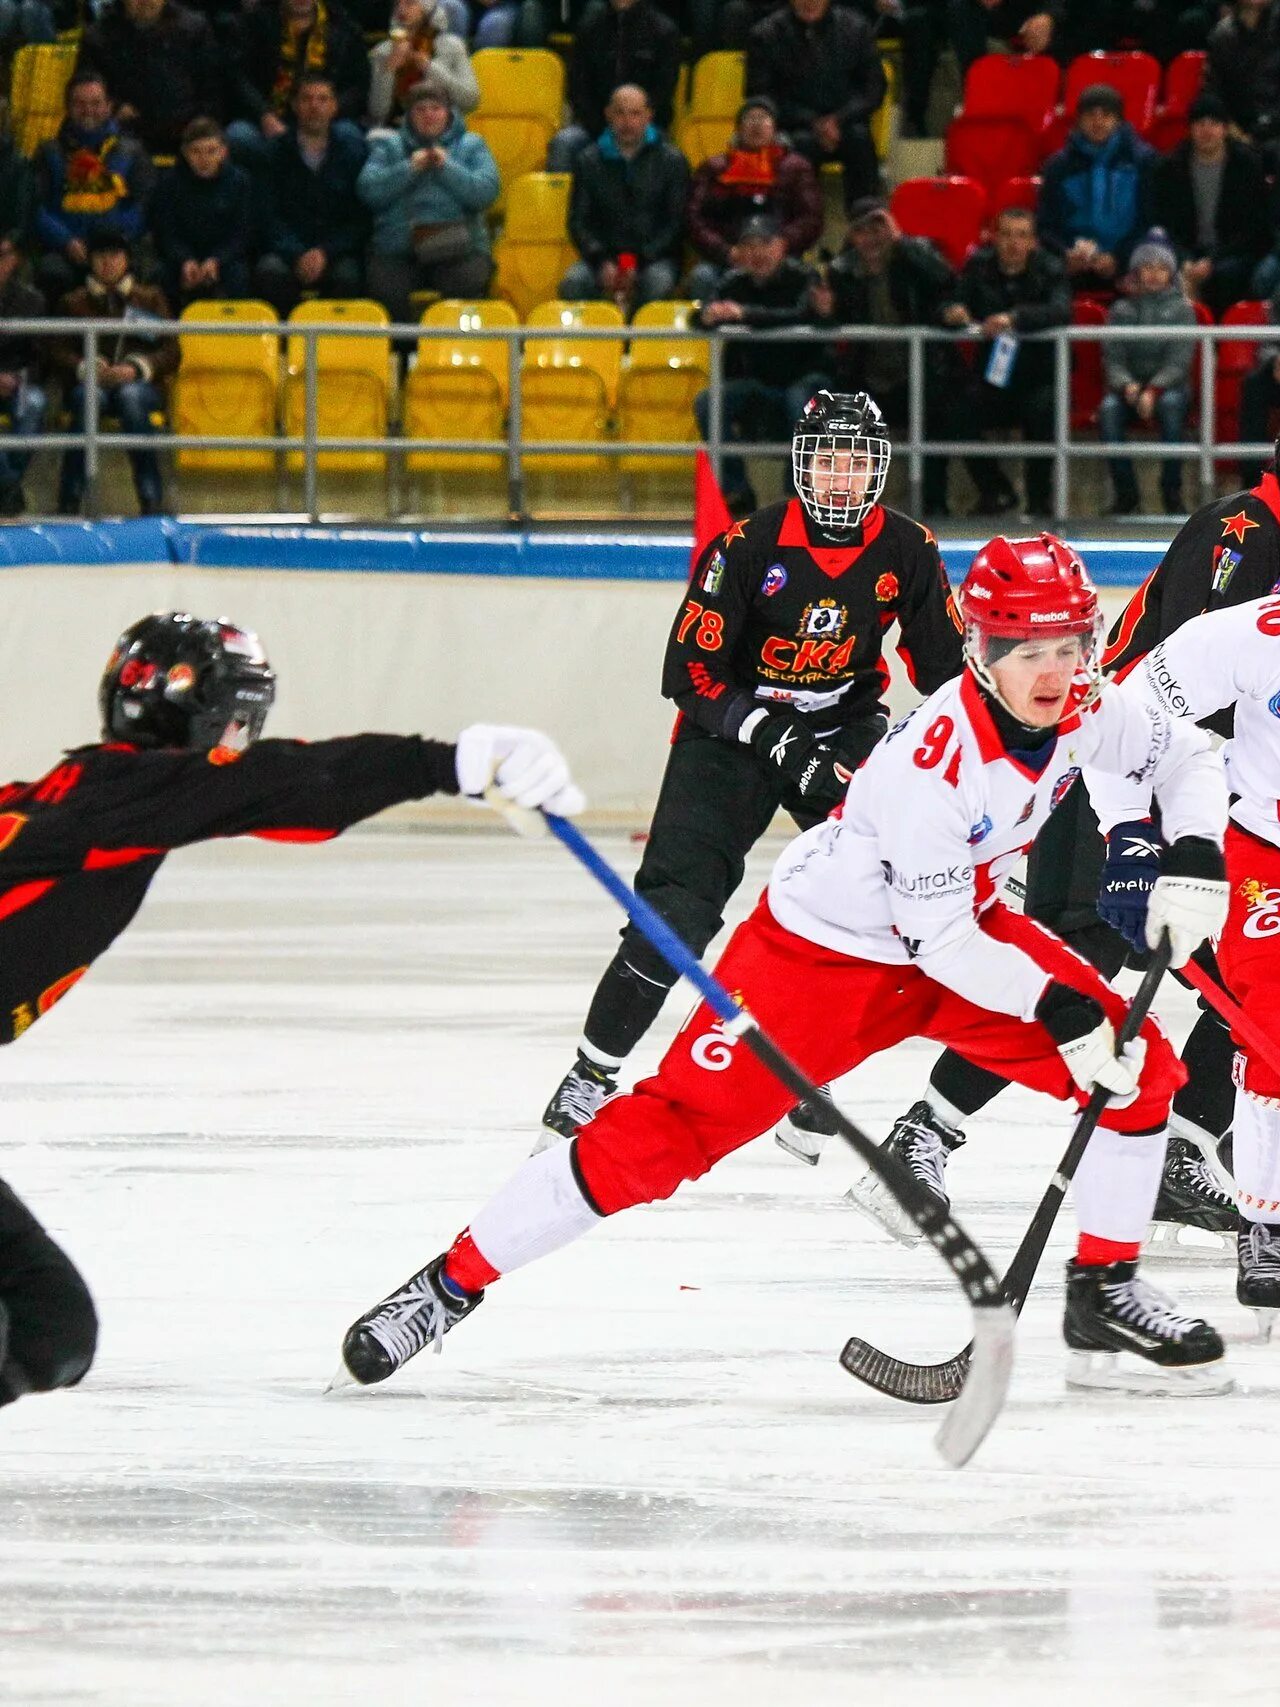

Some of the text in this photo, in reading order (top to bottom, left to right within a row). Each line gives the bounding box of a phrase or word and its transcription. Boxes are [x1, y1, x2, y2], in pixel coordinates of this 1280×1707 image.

[828, 422, 861, 432] CCM
[676, 599, 725, 652] 78
[1029, 610, 1071, 624] Reebok
[760, 634, 857, 675] СКА
